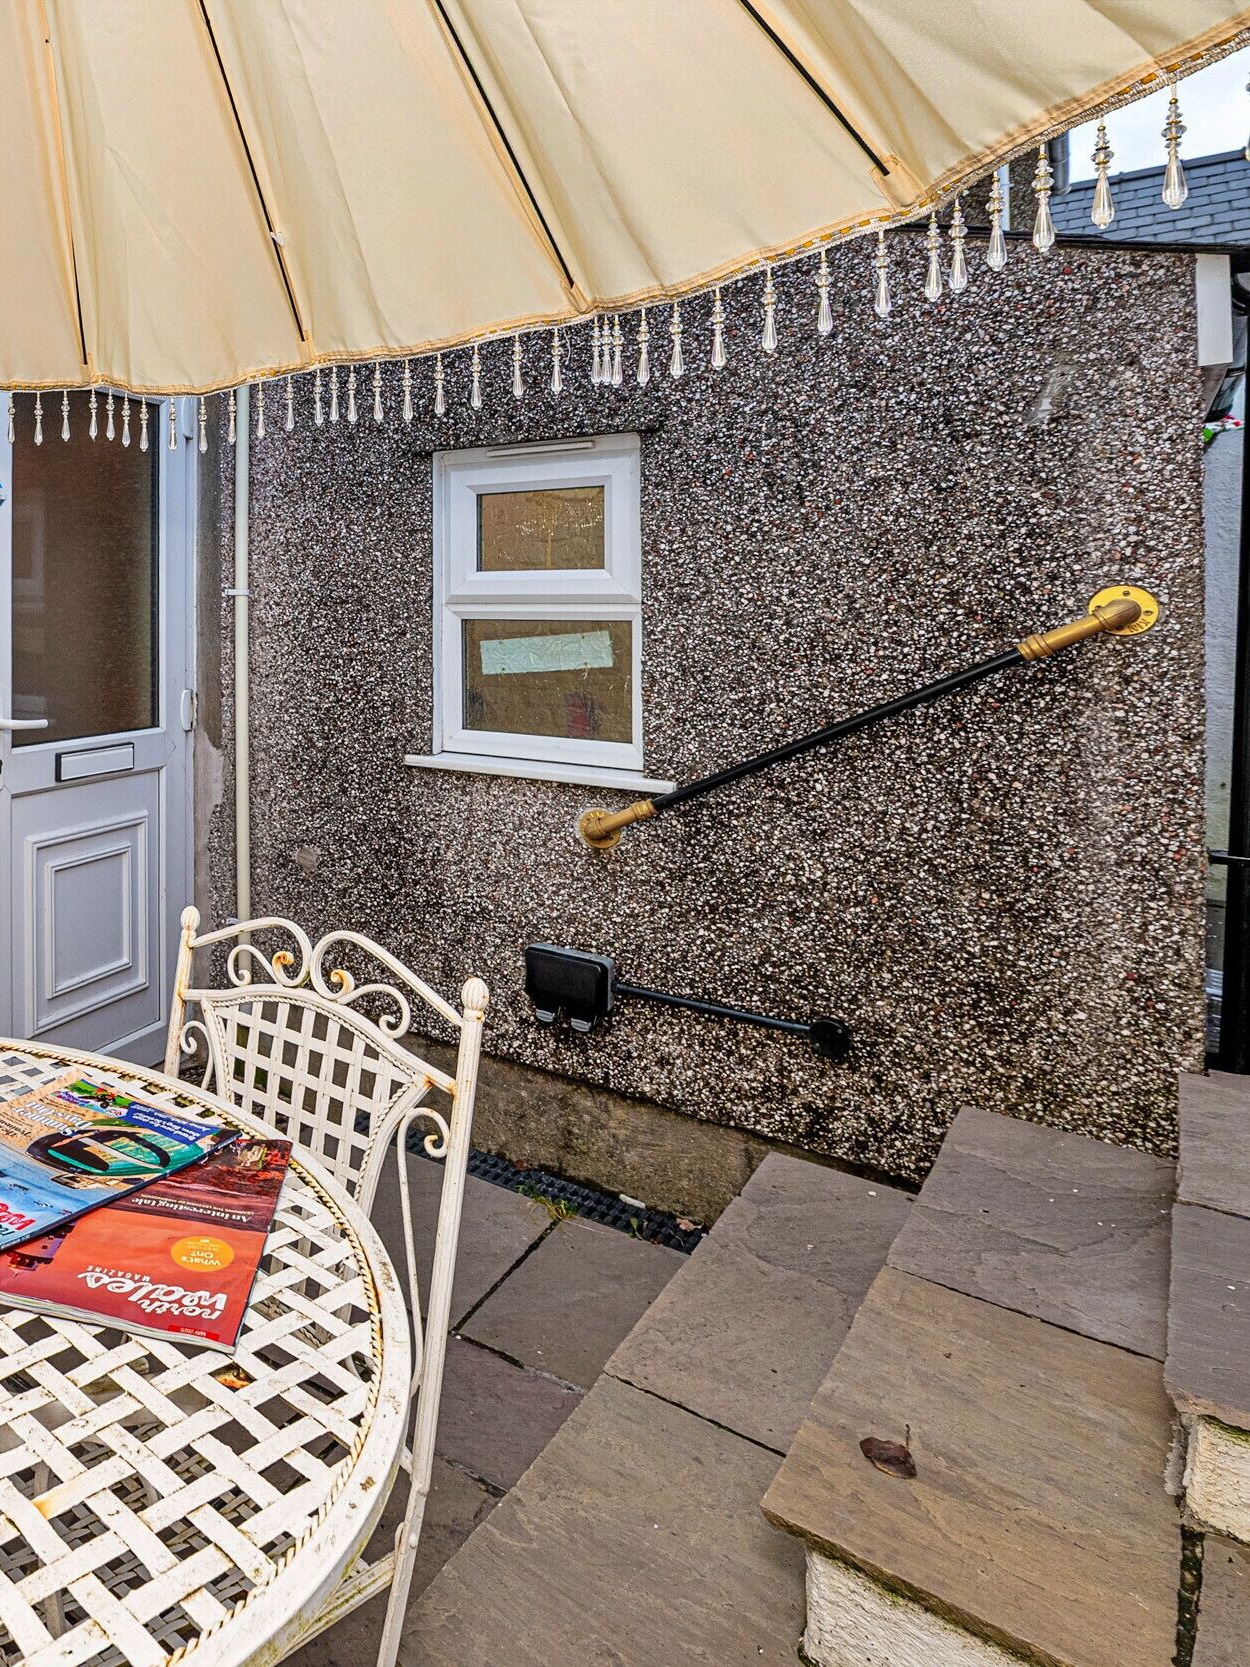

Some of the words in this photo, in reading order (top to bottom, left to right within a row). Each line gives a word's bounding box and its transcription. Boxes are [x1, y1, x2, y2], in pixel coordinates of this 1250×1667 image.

[11, 1106, 78, 1135] Summer
[132, 1196, 155, 1205] tale
[158, 1199, 228, 1218] interesting
[231, 1214, 251, 1223] An
[180, 1255, 220, 1265] What's
[190, 1250, 212, 1258] On?
[85, 1264, 150, 1282] MAGAZINE
[76, 1271, 227, 1310] wales
[136, 1299, 221, 1320] north
